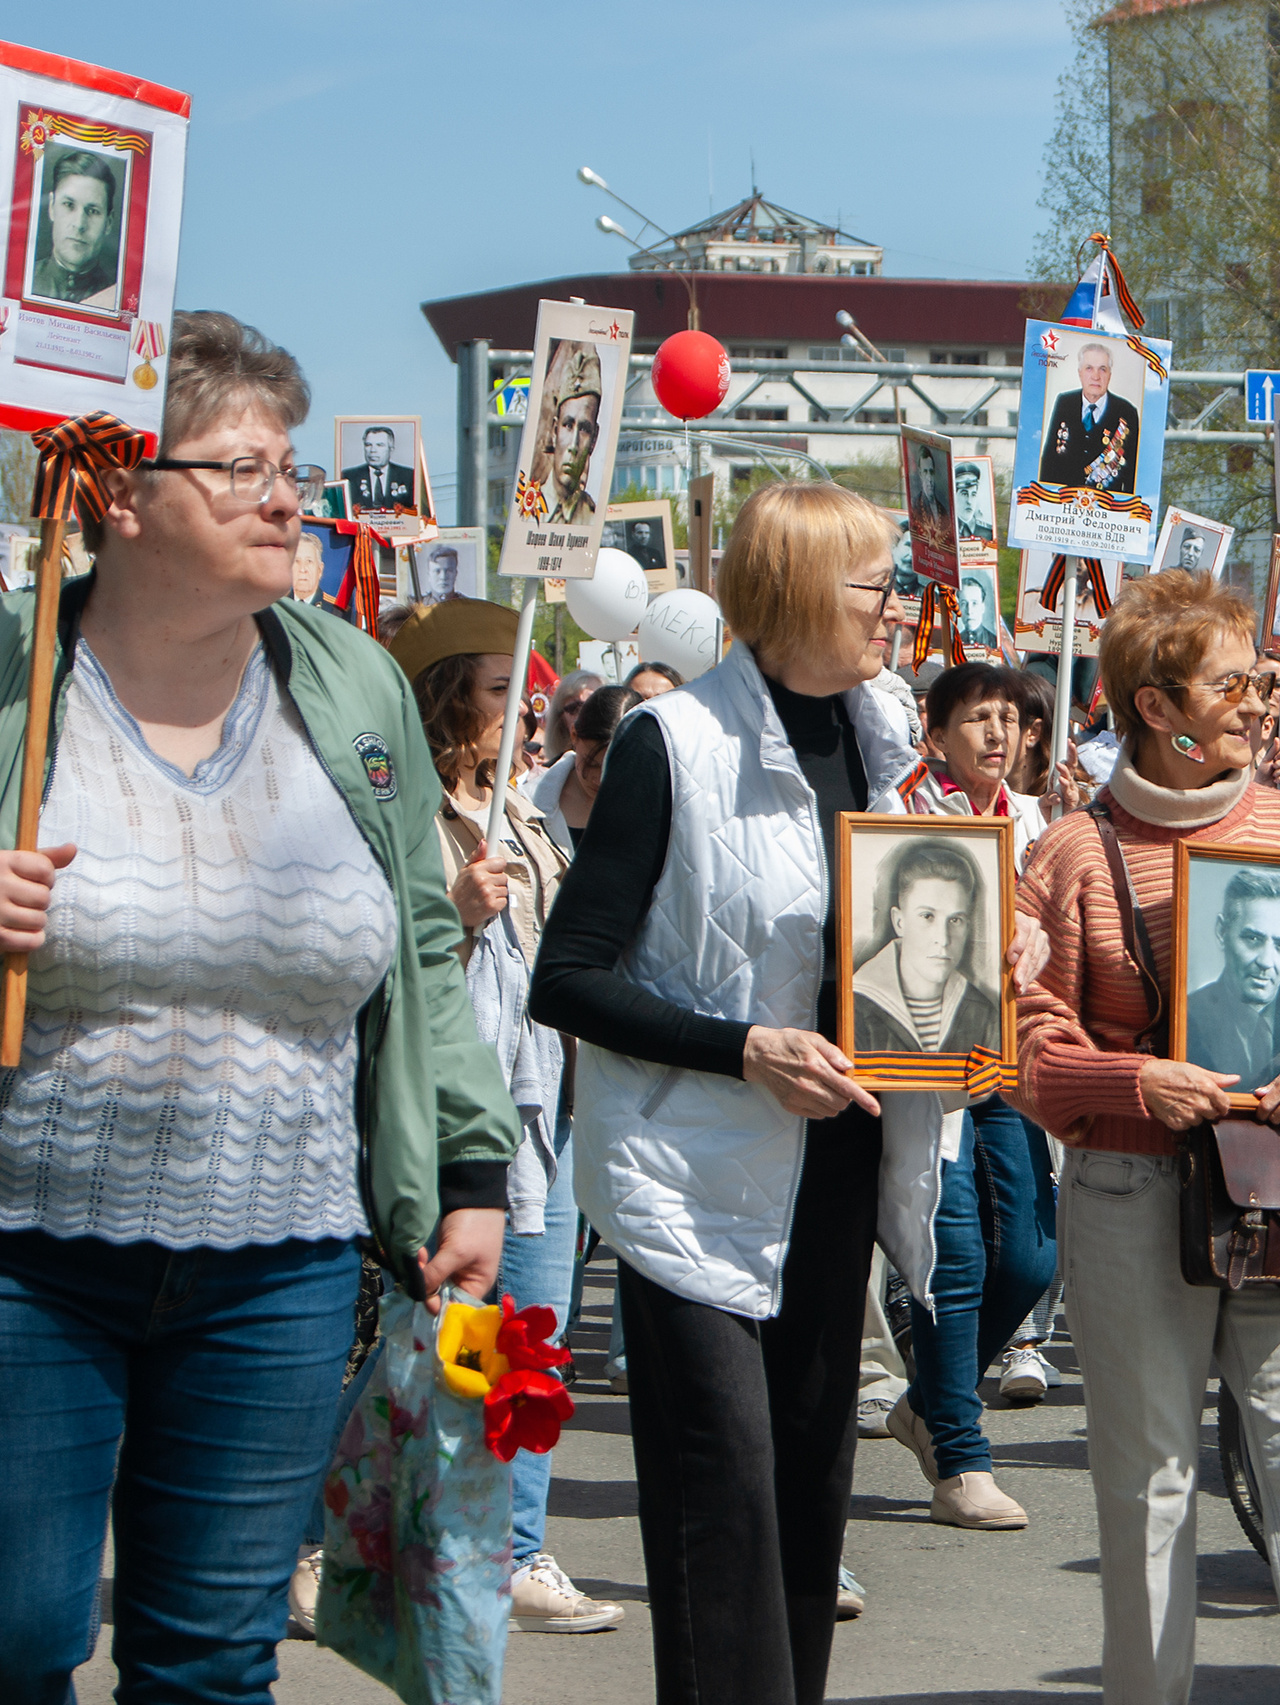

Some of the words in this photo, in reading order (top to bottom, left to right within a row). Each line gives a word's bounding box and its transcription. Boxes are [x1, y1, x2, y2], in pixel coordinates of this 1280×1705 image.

[19, 313, 45, 325] Изотов
[49, 318, 80, 331] Михаил
[85, 326, 126, 341] Васильевич
[1062, 503, 1108, 519] Наумов
[1025, 510, 1075, 526] Дмитрий
[1083, 517, 1142, 534] Федорович
[548, 532, 565, 550] Шакир
[1035, 534, 1068, 544] 19.09.1919
[1081, 539, 1114, 550] 05.09.2016
[1038, 524, 1102, 540] подполковник
[1105, 533, 1125, 543] ВДВ
